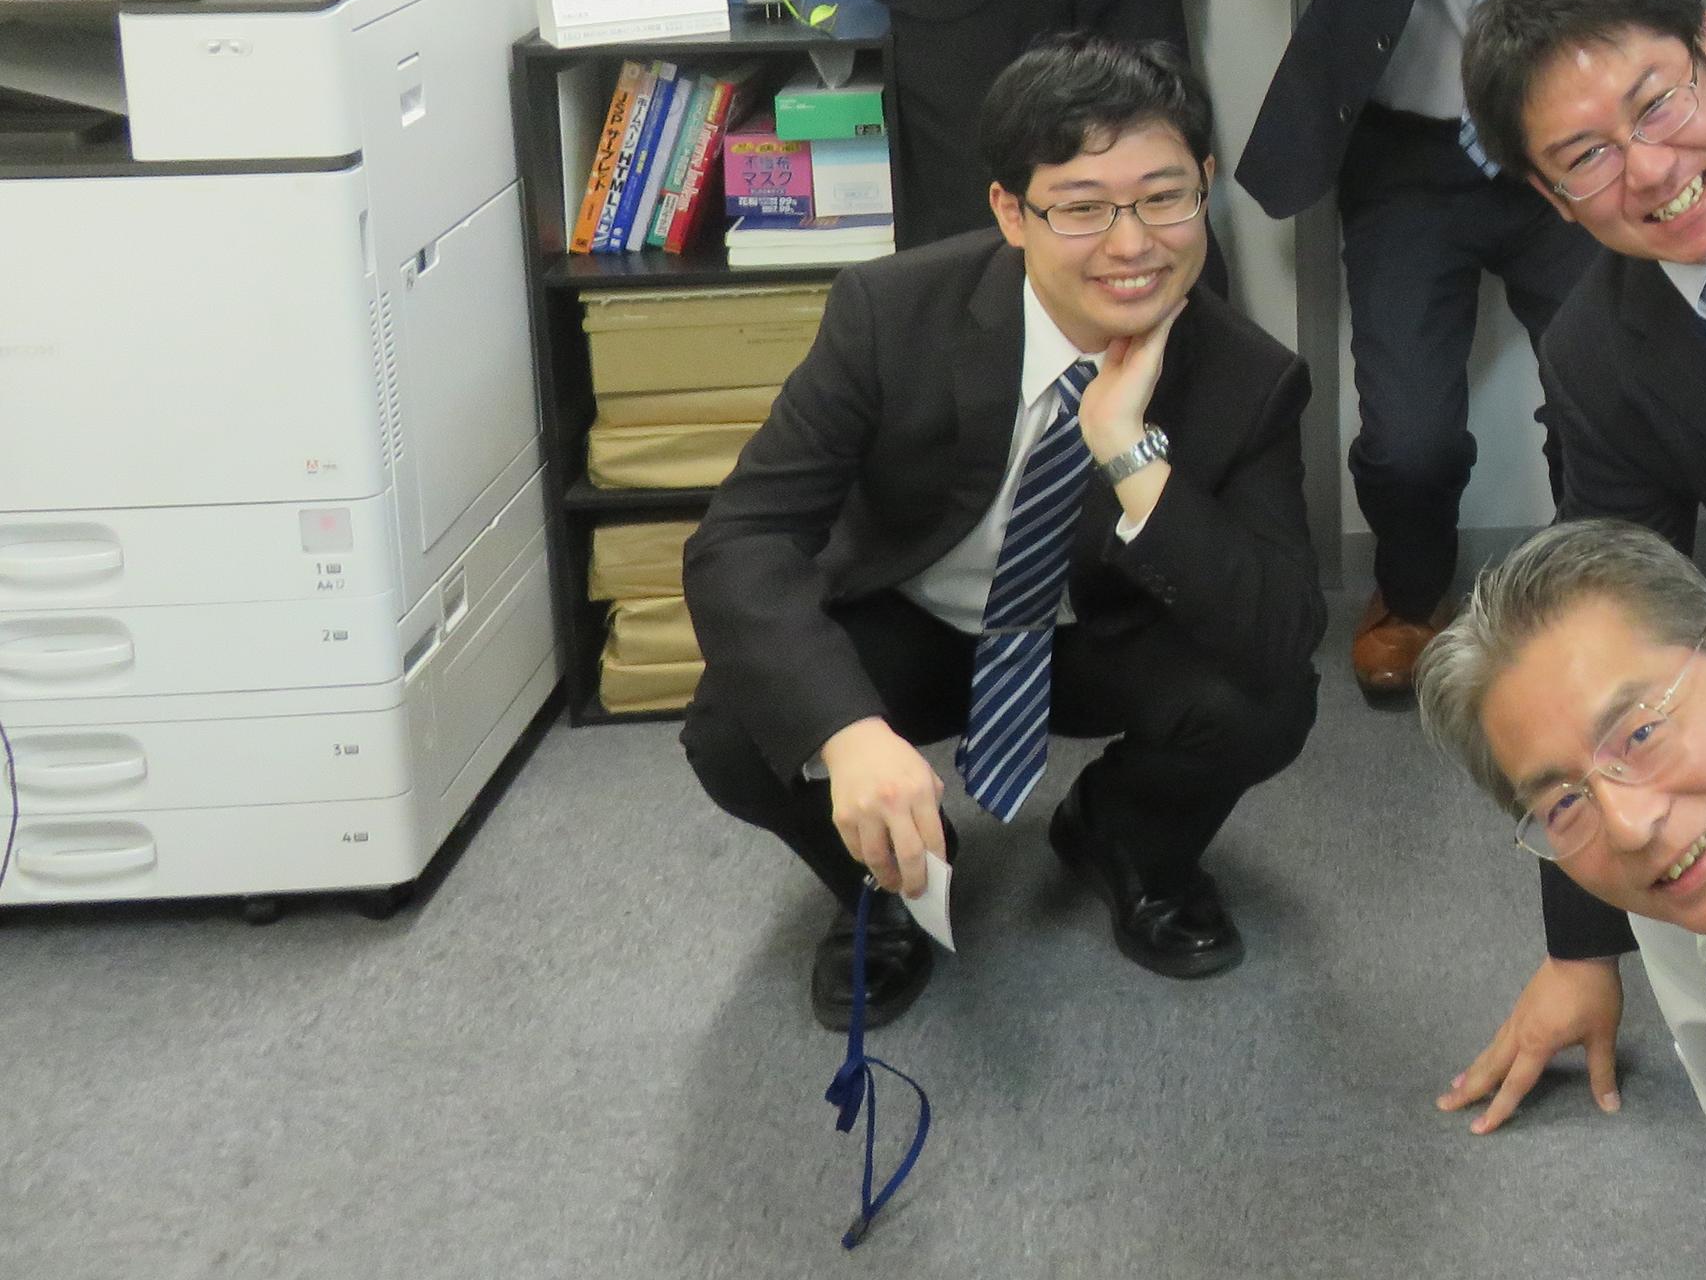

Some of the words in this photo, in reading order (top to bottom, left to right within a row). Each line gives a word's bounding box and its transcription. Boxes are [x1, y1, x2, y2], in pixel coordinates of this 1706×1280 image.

[743, 171, 793, 186] マスク
[322, 630, 330, 641] 2
[333, 744, 341, 756] 3
[342, 832, 351, 843] 4
